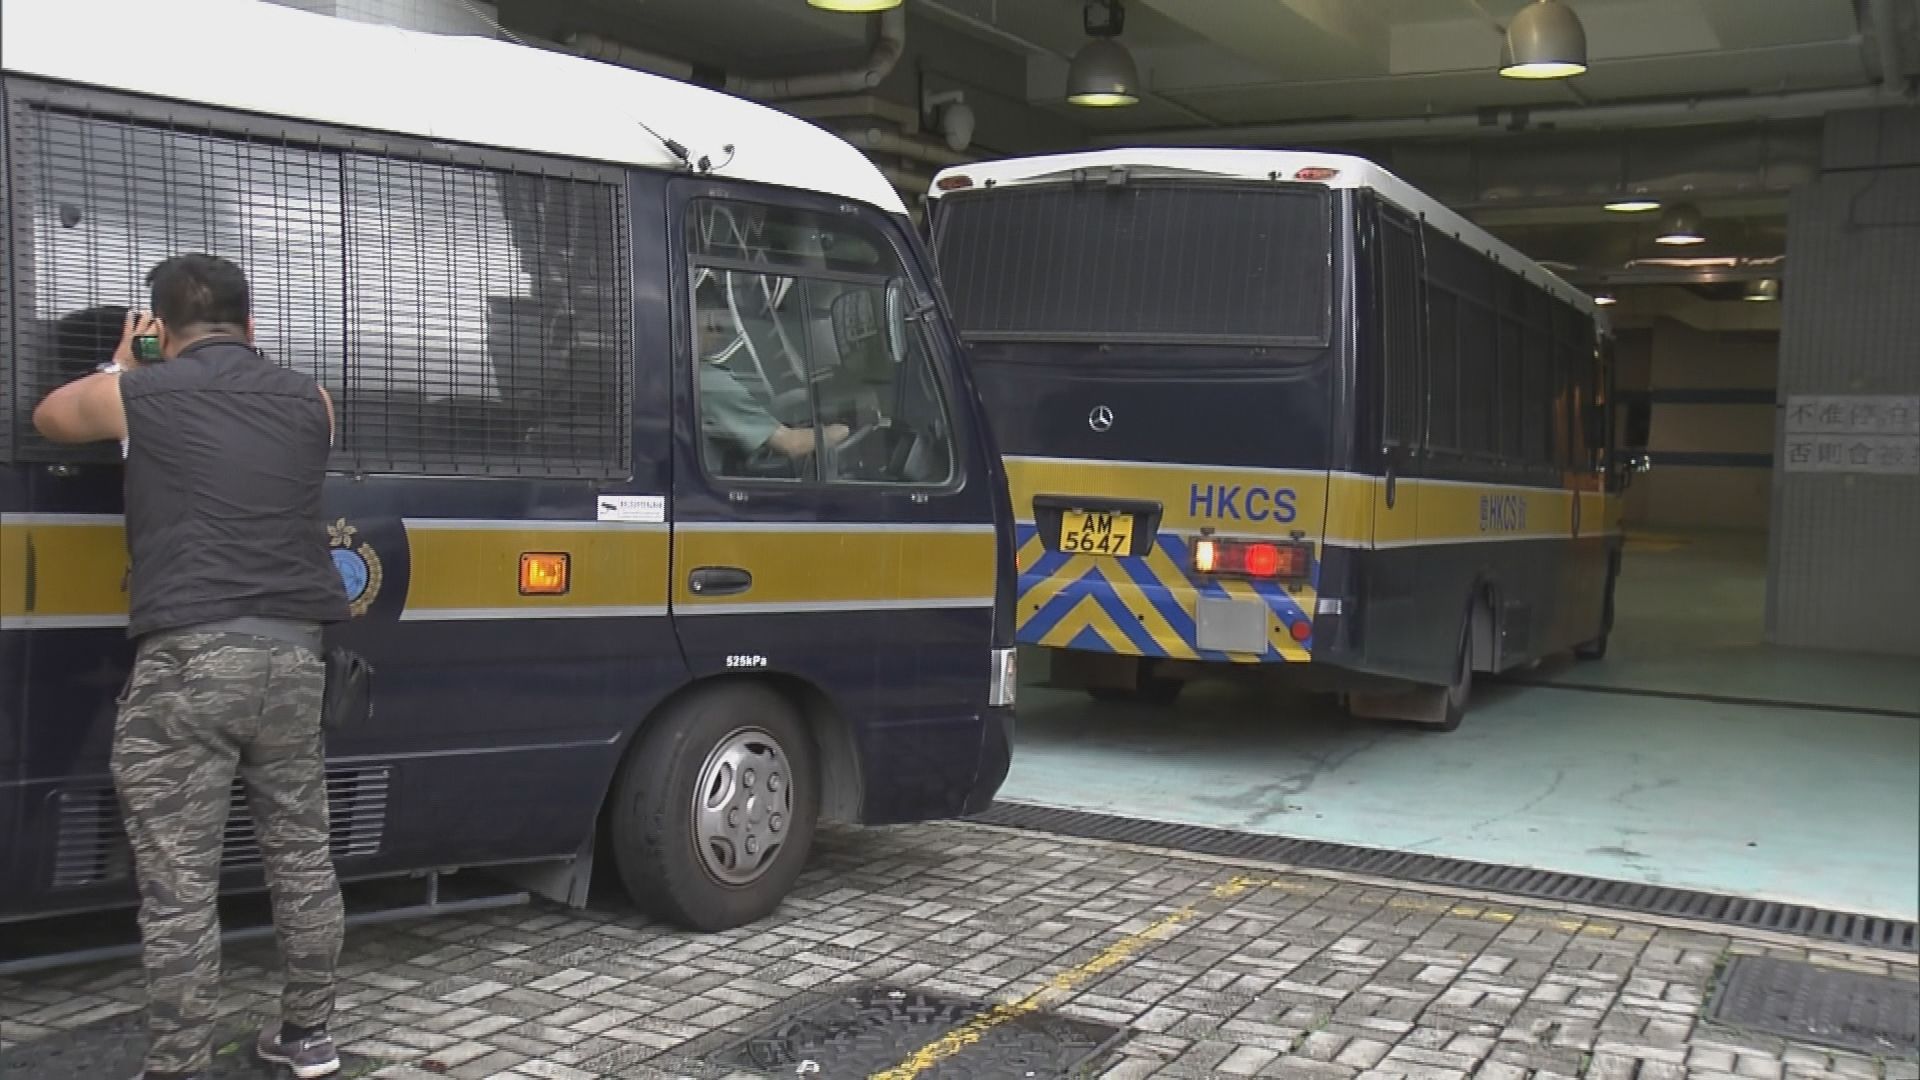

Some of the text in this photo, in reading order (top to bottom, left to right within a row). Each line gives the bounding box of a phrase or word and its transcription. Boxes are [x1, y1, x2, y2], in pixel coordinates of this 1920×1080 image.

[1786, 441, 1919, 466] 否則會被
[1190, 484, 1297, 523] HKCS
[1082, 513, 1113, 534] AM
[1064, 532, 1126, 555] 5647
[726, 655, 768, 667] 525kPa
